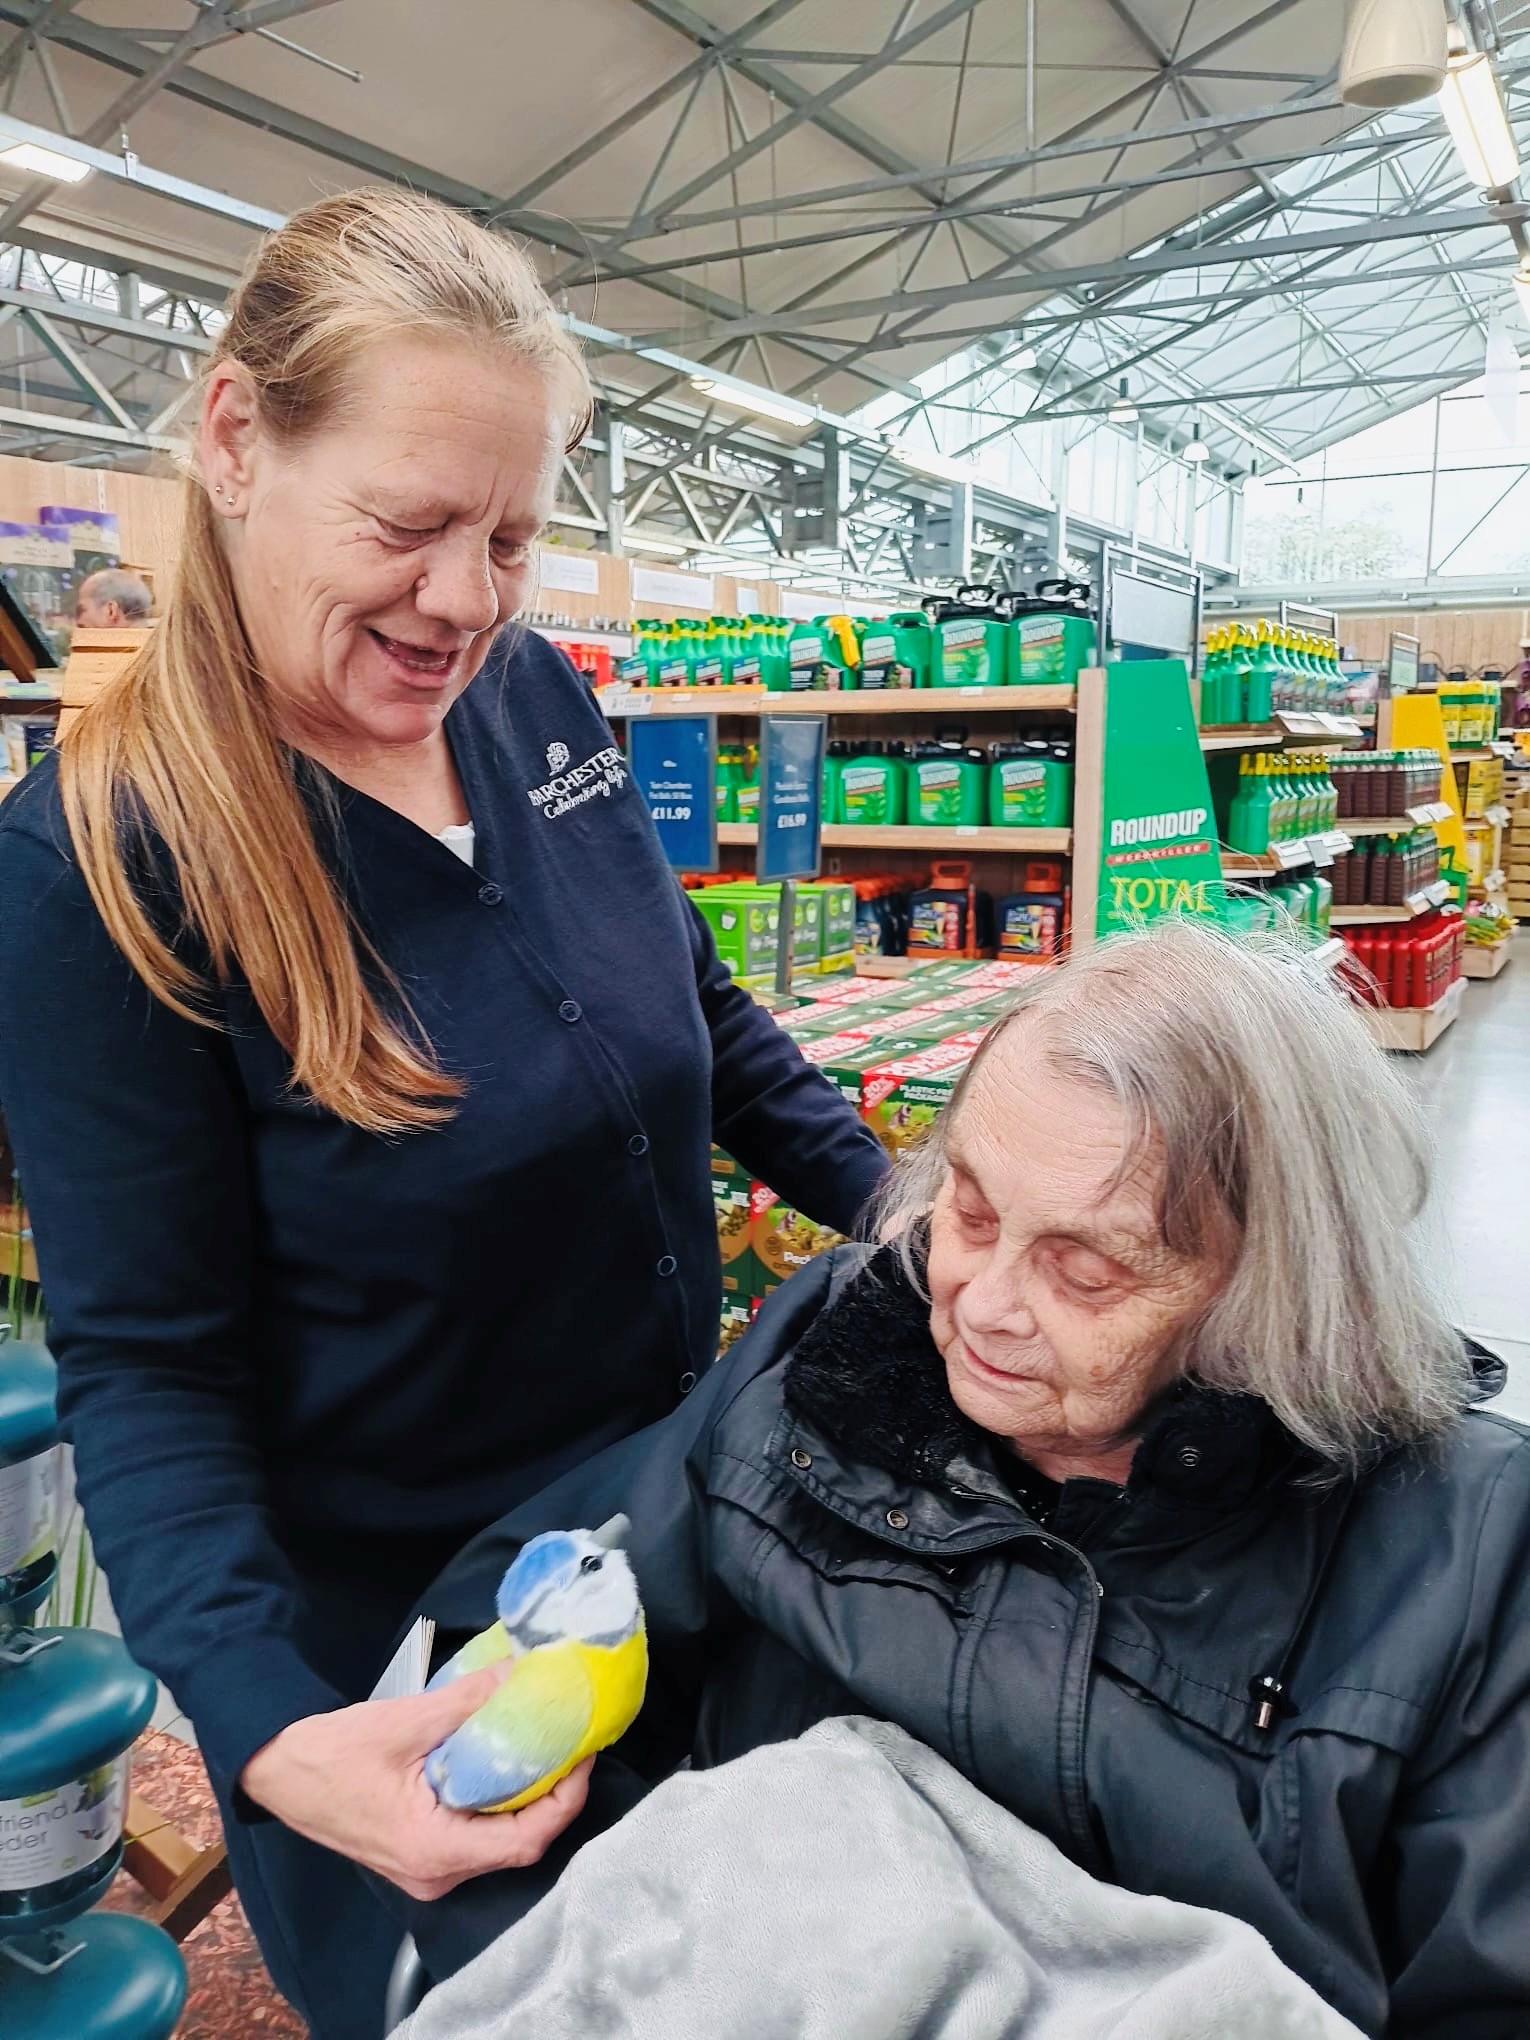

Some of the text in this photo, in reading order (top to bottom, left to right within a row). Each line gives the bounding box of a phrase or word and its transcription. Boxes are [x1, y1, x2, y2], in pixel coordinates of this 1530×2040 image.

[651, 806, 692, 820] £11.99
[1110, 808, 1208, 847] ROUNDUP
[1109, 877, 1216, 913] TOTAL
